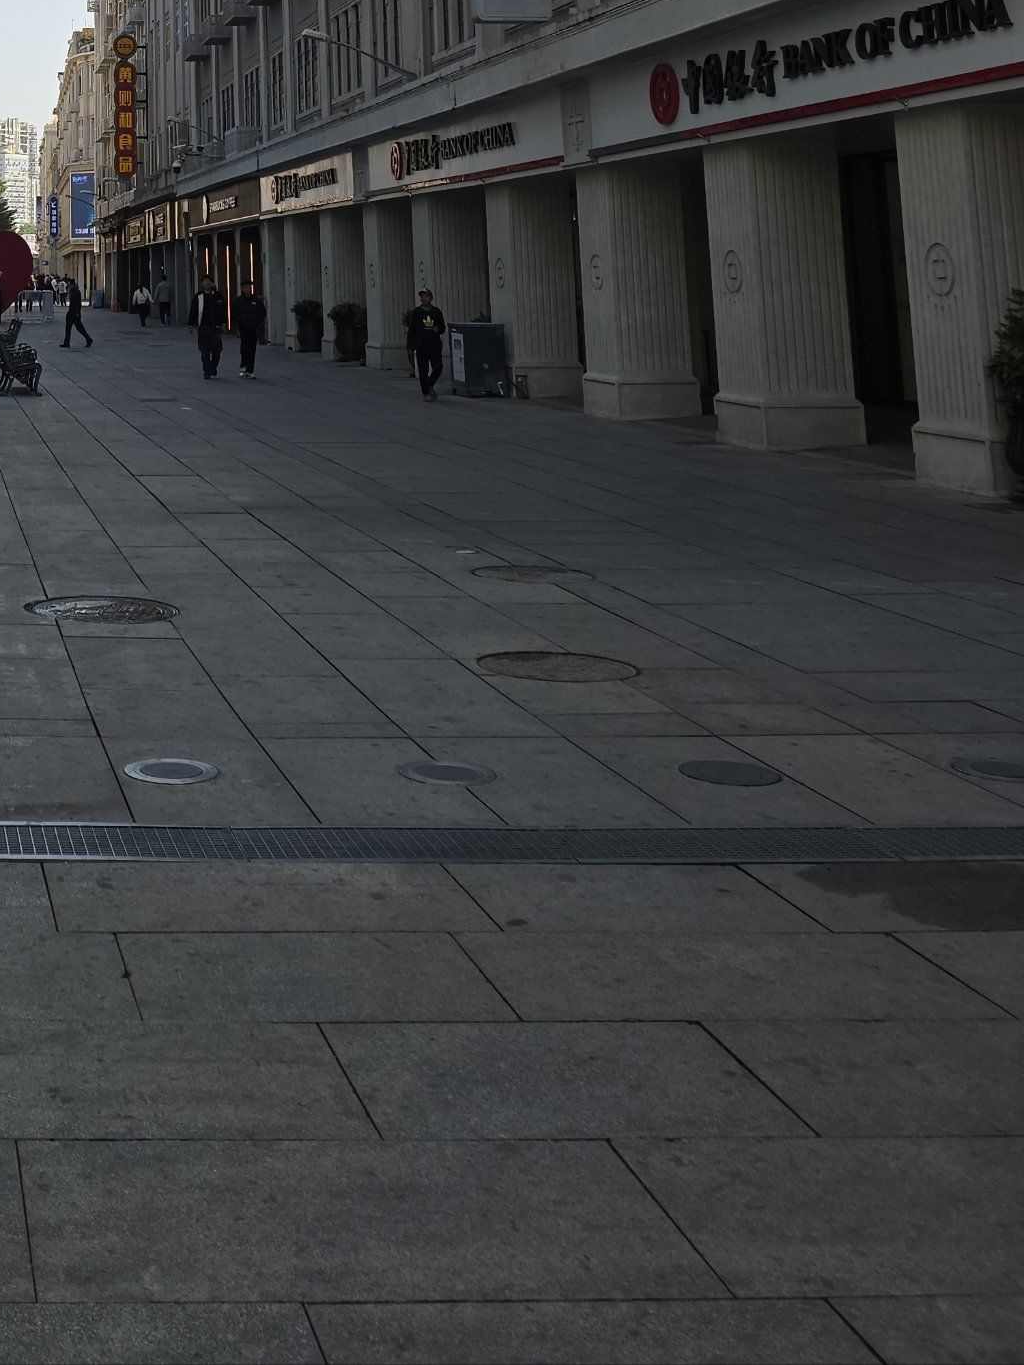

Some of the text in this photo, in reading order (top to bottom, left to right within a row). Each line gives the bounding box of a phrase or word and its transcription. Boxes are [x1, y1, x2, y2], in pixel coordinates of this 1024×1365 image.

[780, 28, 856, 78] BANK
[854, 17, 896, 59] OF
[118, 67, 133, 172] 黄则和食品
[480, 122, 516, 151] CHINA
